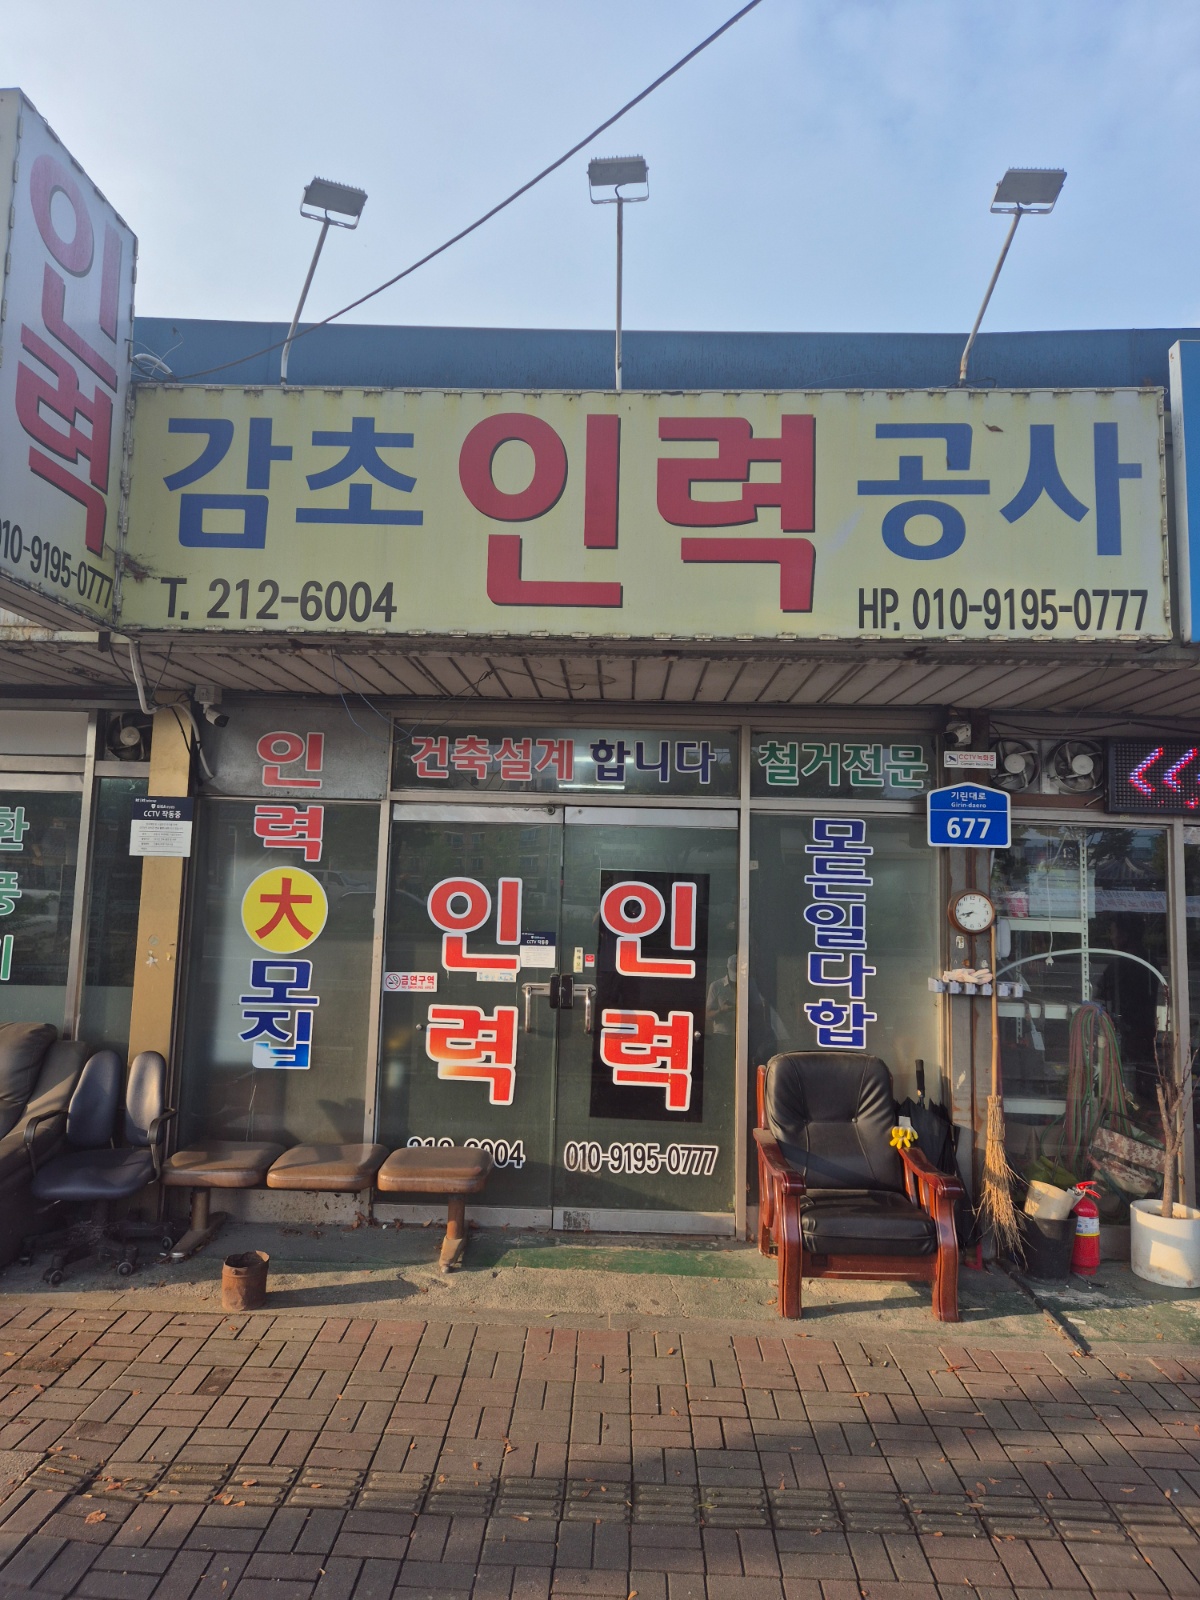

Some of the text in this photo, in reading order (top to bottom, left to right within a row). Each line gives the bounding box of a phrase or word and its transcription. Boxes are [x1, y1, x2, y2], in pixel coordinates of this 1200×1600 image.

[15, 153, 124, 559] 인력
[162, 411, 1143, 614] 감초 인력 공사
[0, 518, 114, 609] 10-9195-0777
[160, 577, 398, 623] T. 212-6004
[857, 587, 1149, 632] HP. 010-9195-0777
[410, 735, 717, 785] 건축설계 합니다
[758, 740, 929, 789] 철거전문
[253, 730, 326, 863] 인력
[950, 791, 987, 802] 기린대로
[950, 801, 987, 809] Girin-daero
[946, 816, 992, 839] 677
[803, 817, 877, 1050] 모든일다합
[401, 974, 435, 986] 금연구역
[426, 876, 523, 1106] 인력
[600, 881, 697, 1112] 인력
[238, 958, 320, 1070] 모집
[563, 1141, 719, 1176] 010-9195-0777
